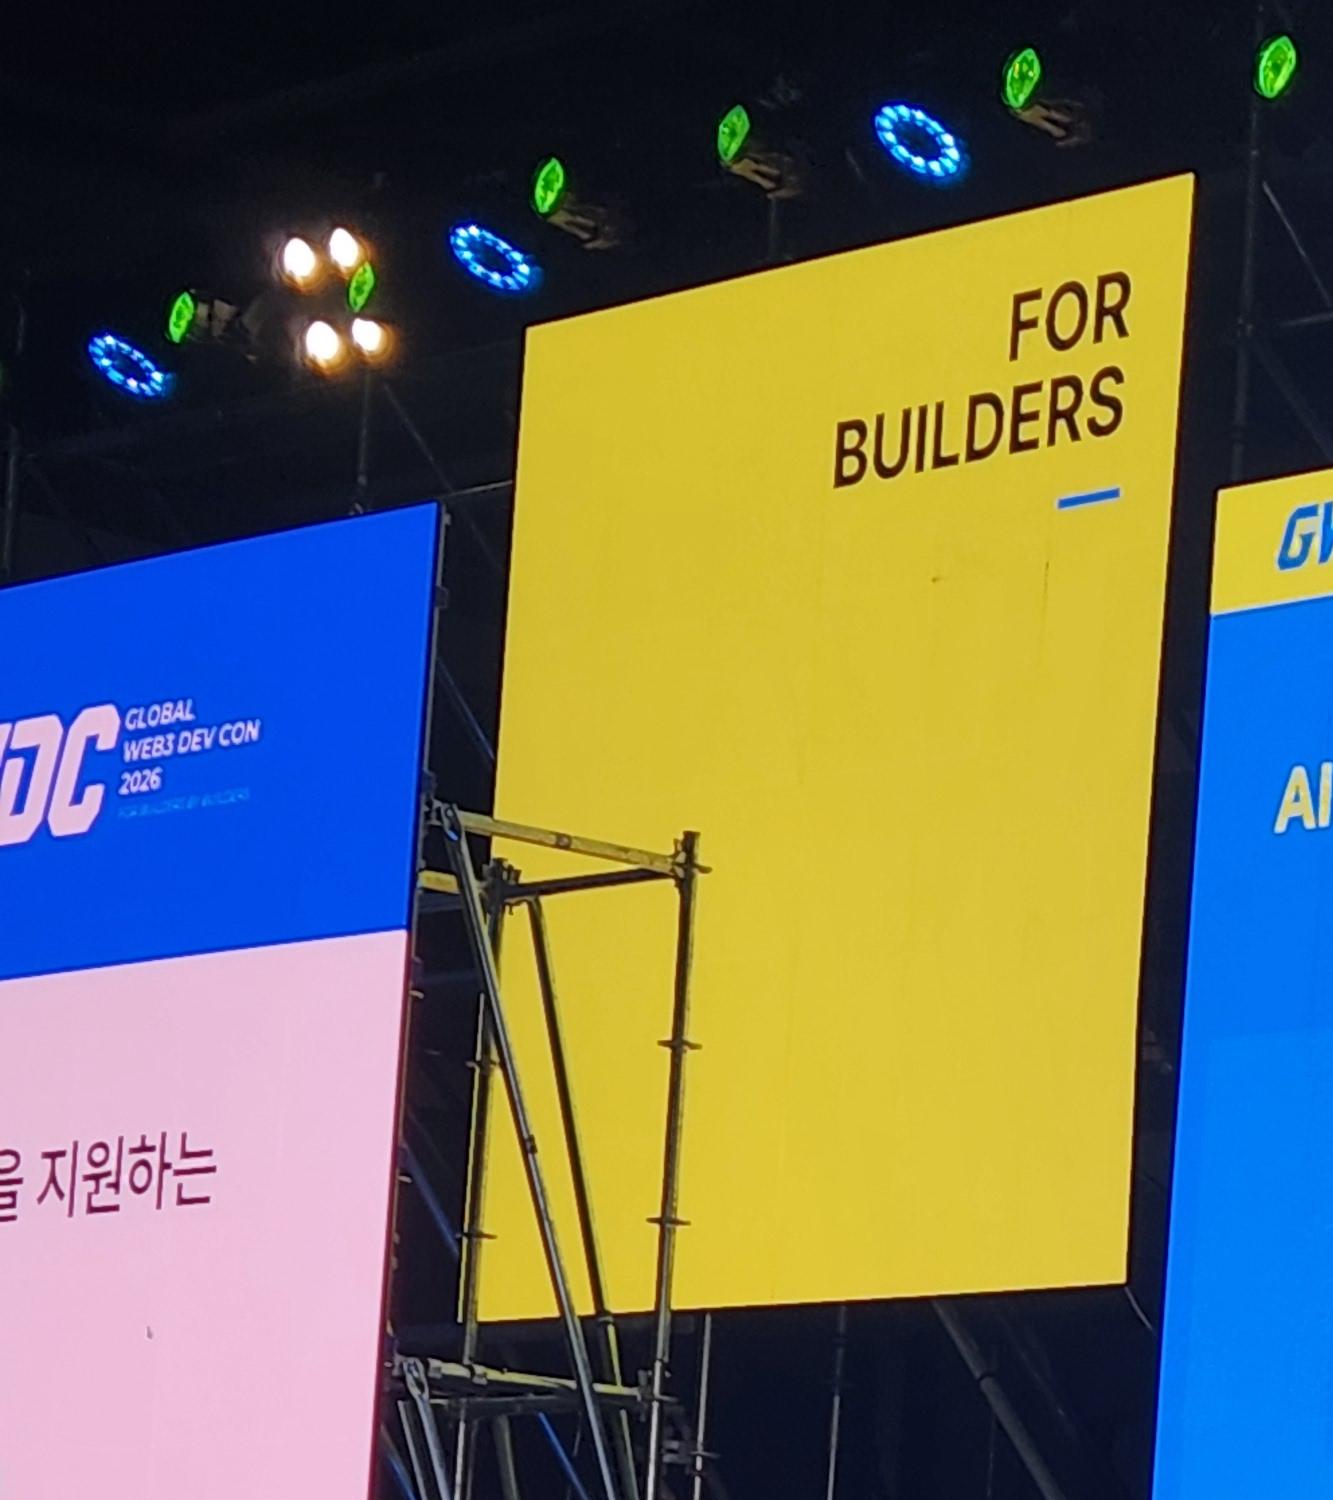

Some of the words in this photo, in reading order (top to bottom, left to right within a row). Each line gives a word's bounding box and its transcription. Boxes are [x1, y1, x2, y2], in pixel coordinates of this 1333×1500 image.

[1008, 270, 1132, 363] FOR
[832, 365, 1125, 490] BUILDERS
[123, 732, 175, 763] WEB3
[177, 725, 217, 754] DEV
[218, 718, 261, 747] CON
[125, 698, 196, 731] GLOBAL
[0, 703, 120, 847] DC
[118, 766, 163, 796] 2026
[1274, 762, 1333, 835] AI
[36, 1131, 217, 1218] 지원하는
